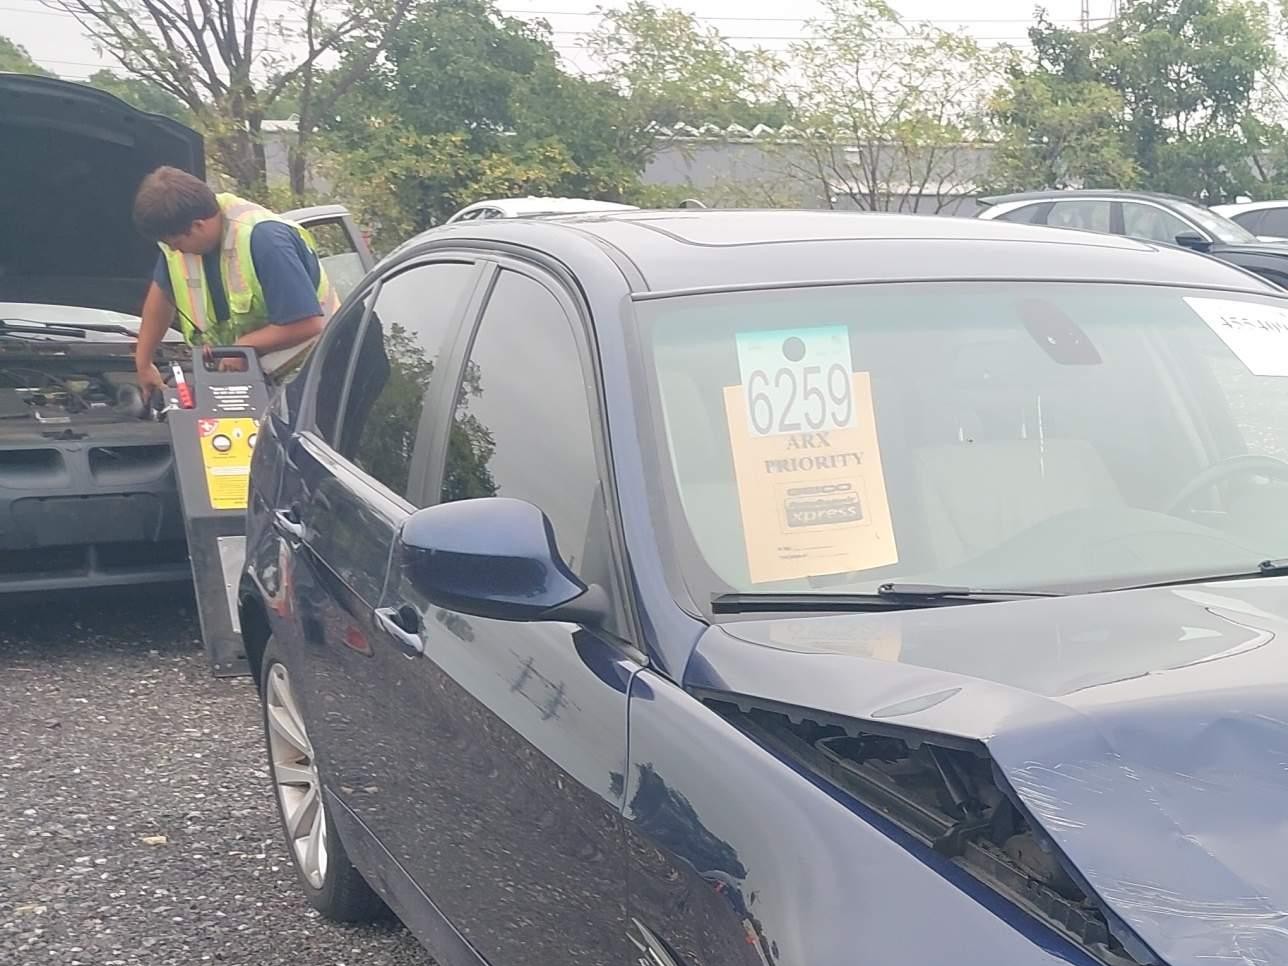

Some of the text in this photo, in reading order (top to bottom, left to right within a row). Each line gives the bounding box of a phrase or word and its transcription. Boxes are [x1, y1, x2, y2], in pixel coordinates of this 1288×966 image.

[748, 363, 852, 435] 6259
[786, 431, 831, 450] ARX
[764, 451, 865, 474] PRIORITY
